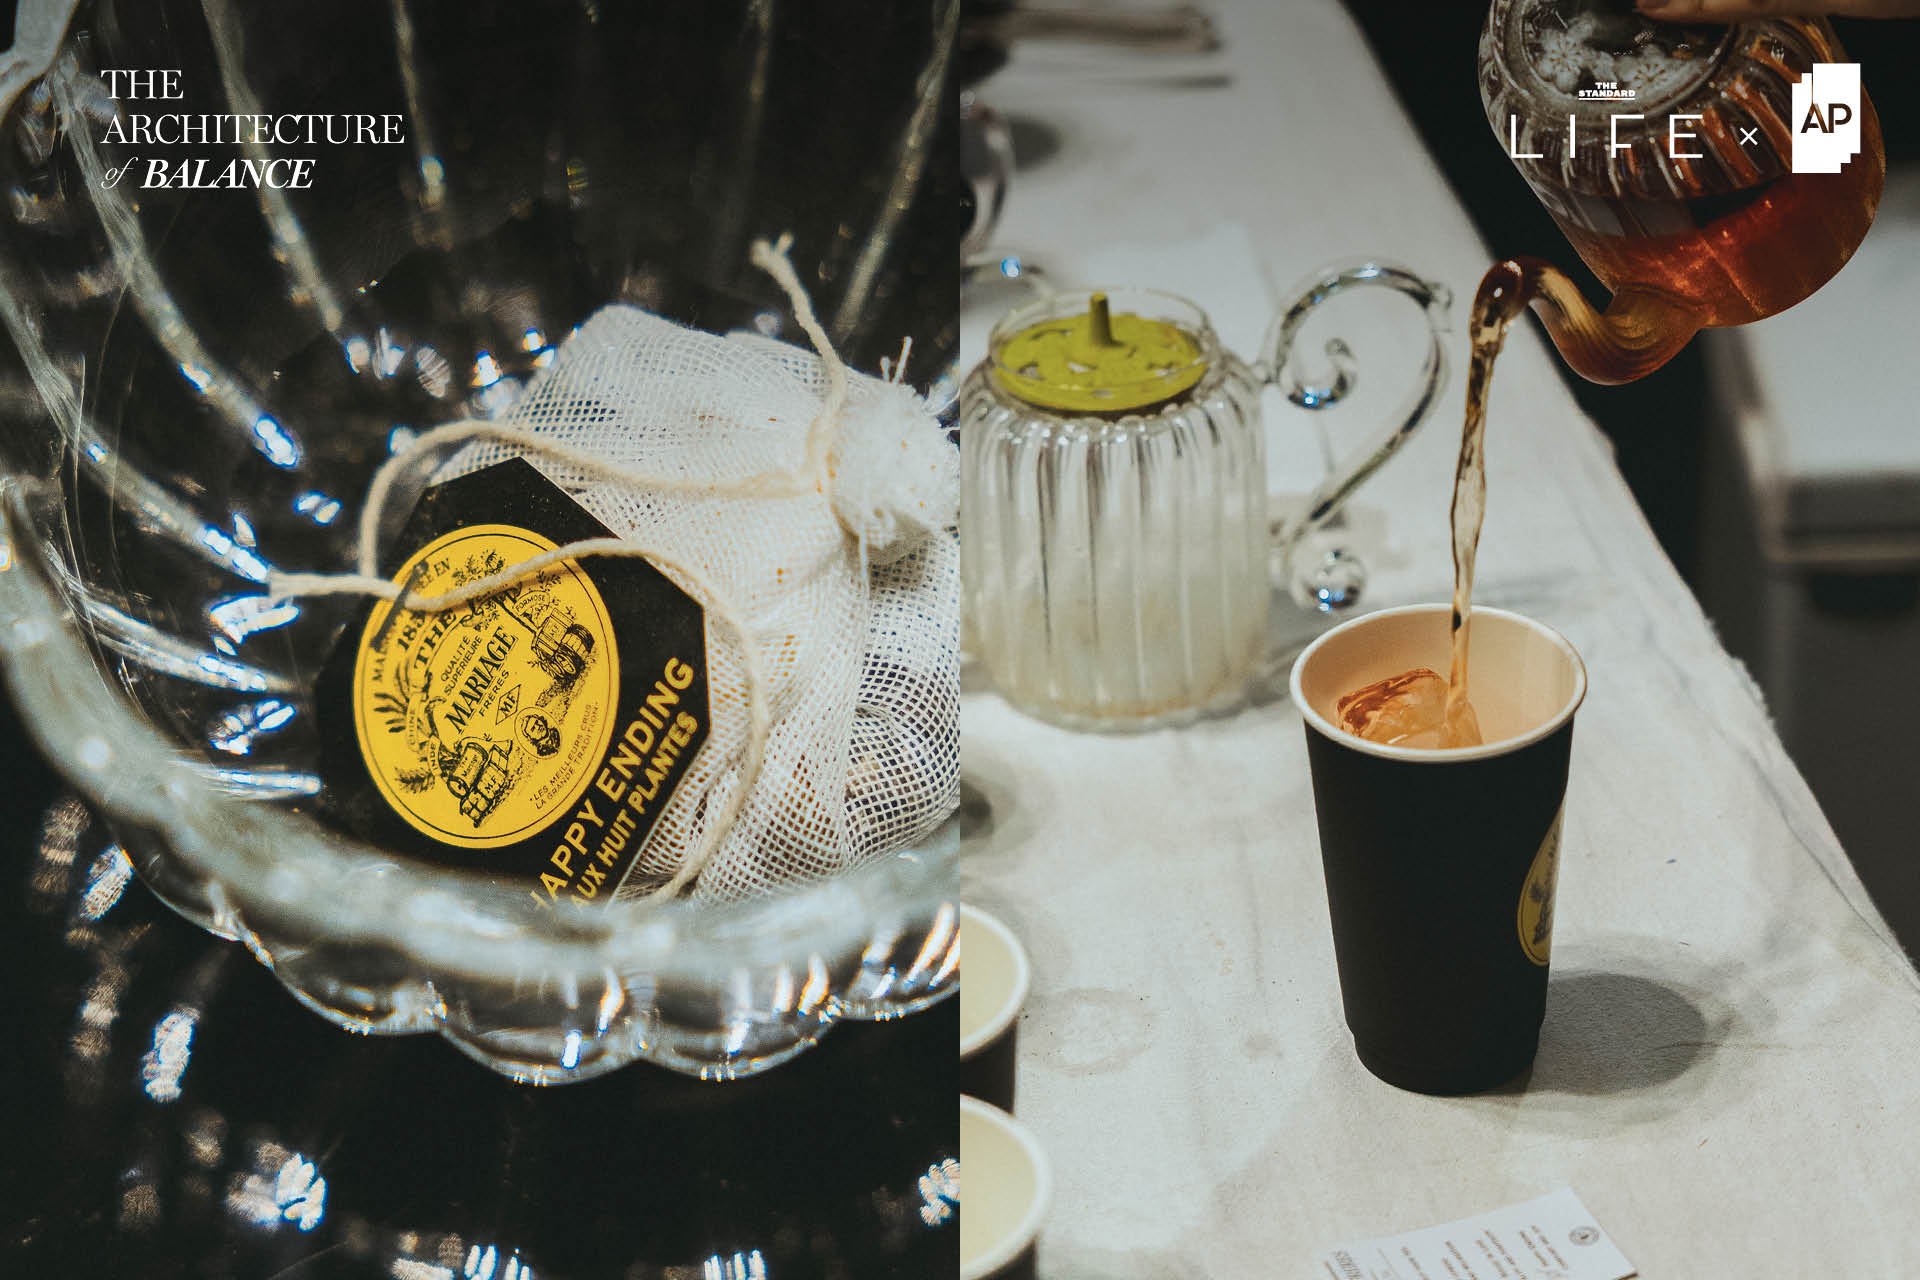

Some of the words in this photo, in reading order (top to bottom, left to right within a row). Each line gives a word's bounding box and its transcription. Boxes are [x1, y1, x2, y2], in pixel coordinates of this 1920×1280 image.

[445, 626, 519, 735] MARIAGE
[499, 691, 516, 718] MF
[596, 657, 694, 802] ENDING
[596, 809, 638, 867] HUIT
[627, 711, 698, 815] PLANTES
